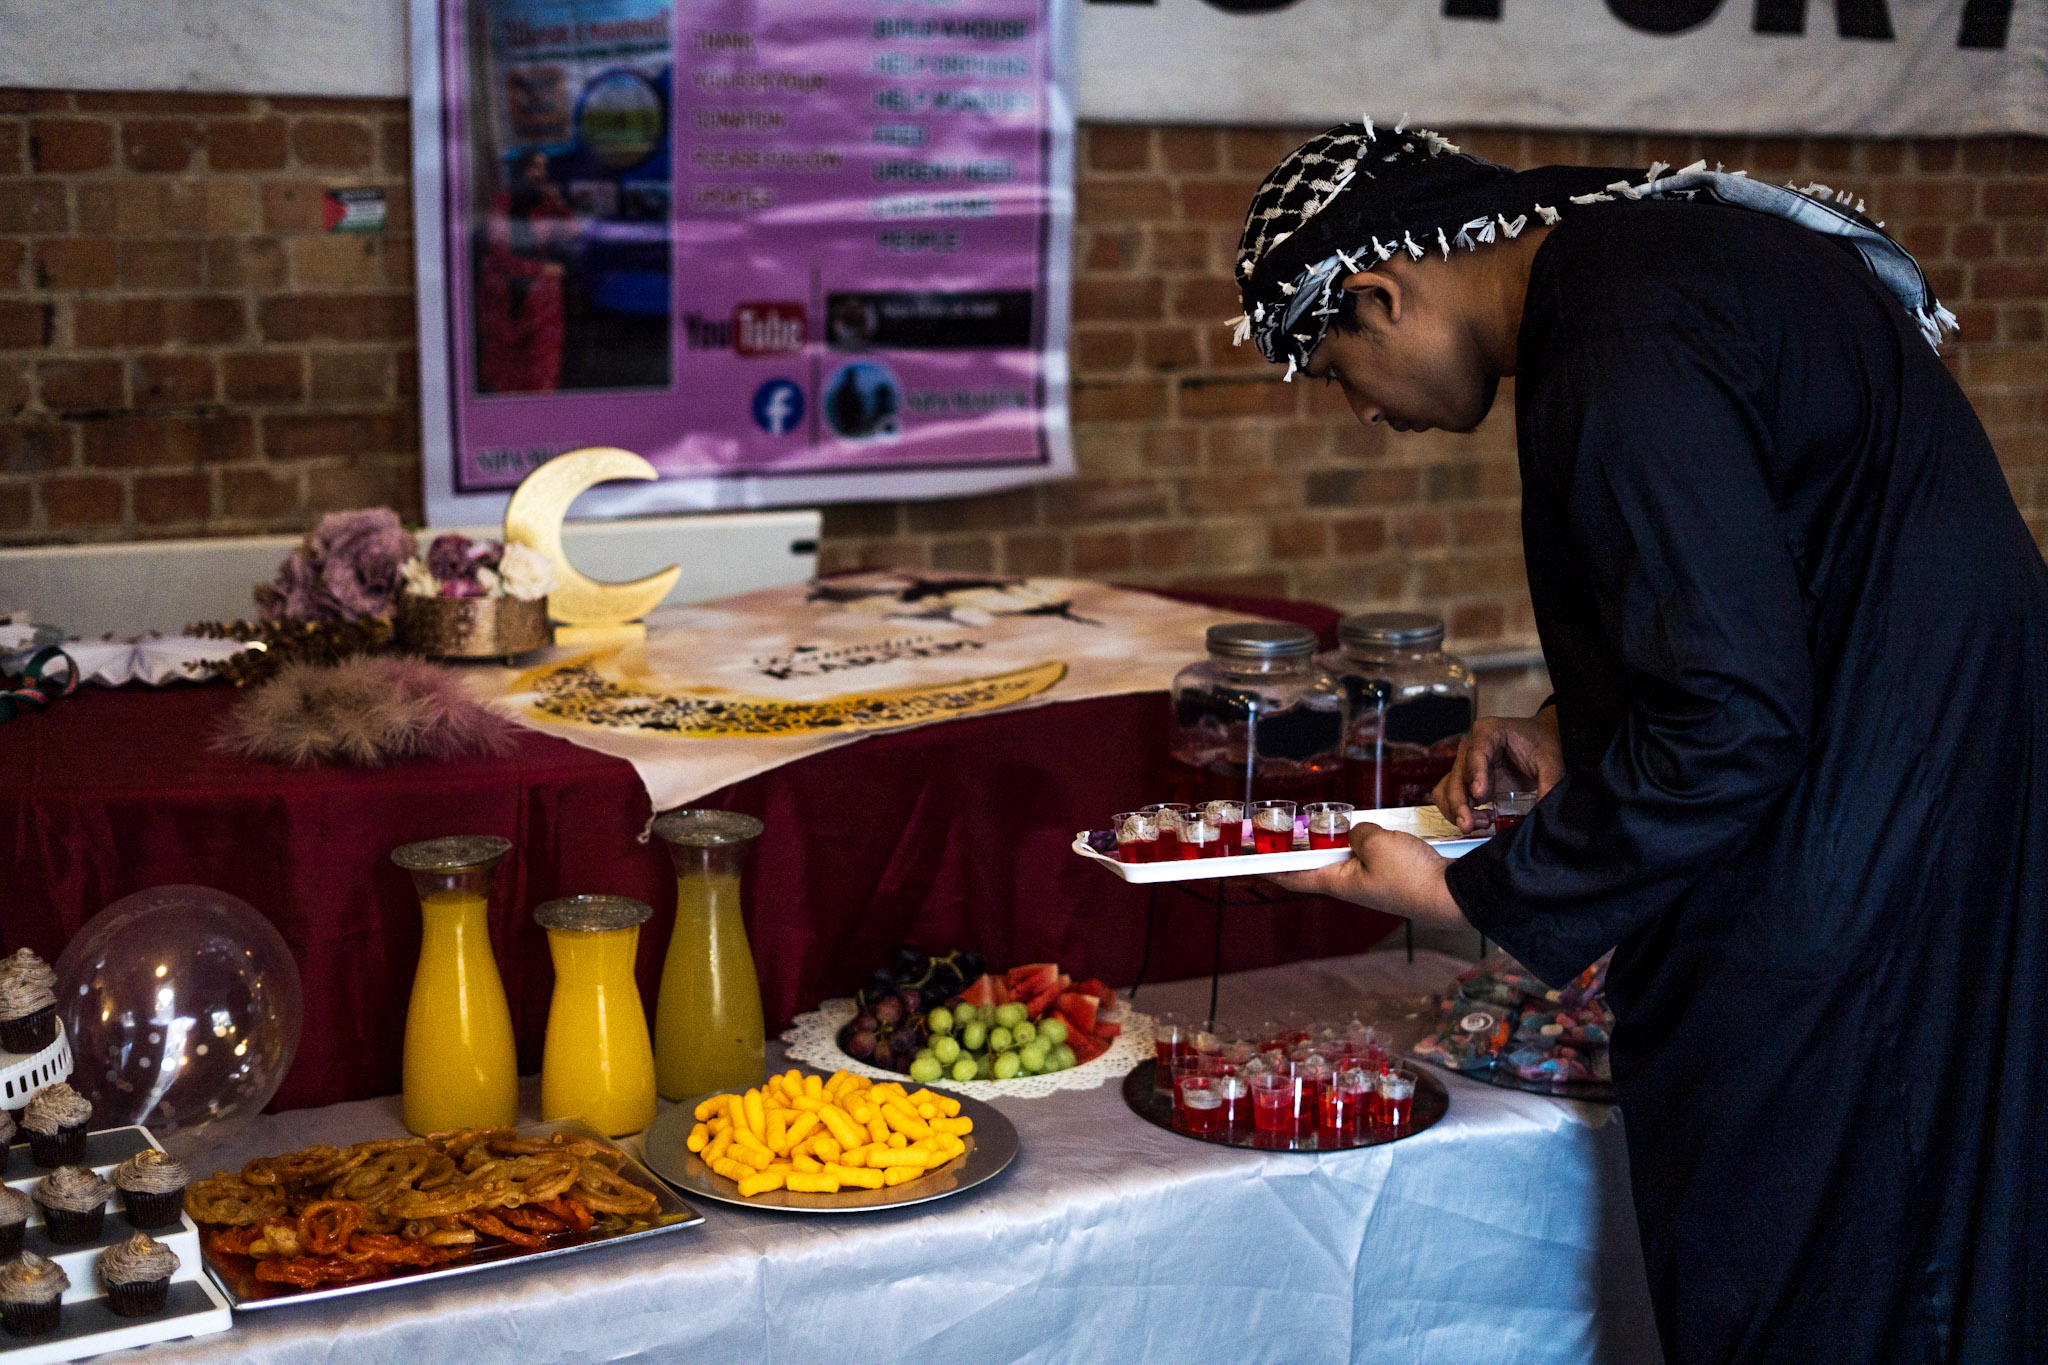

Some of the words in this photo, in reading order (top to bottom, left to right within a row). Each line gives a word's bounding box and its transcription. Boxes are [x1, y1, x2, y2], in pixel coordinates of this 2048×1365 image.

[958, 18, 1026, 39] HOUSE
[694, 31, 753, 50] THANK
[875, 54, 926, 74] HELP
[873, 159, 954, 181] URGENT
[879, 229, 957, 250] PEOPLE
[685, 308, 803, 349] YouTube
